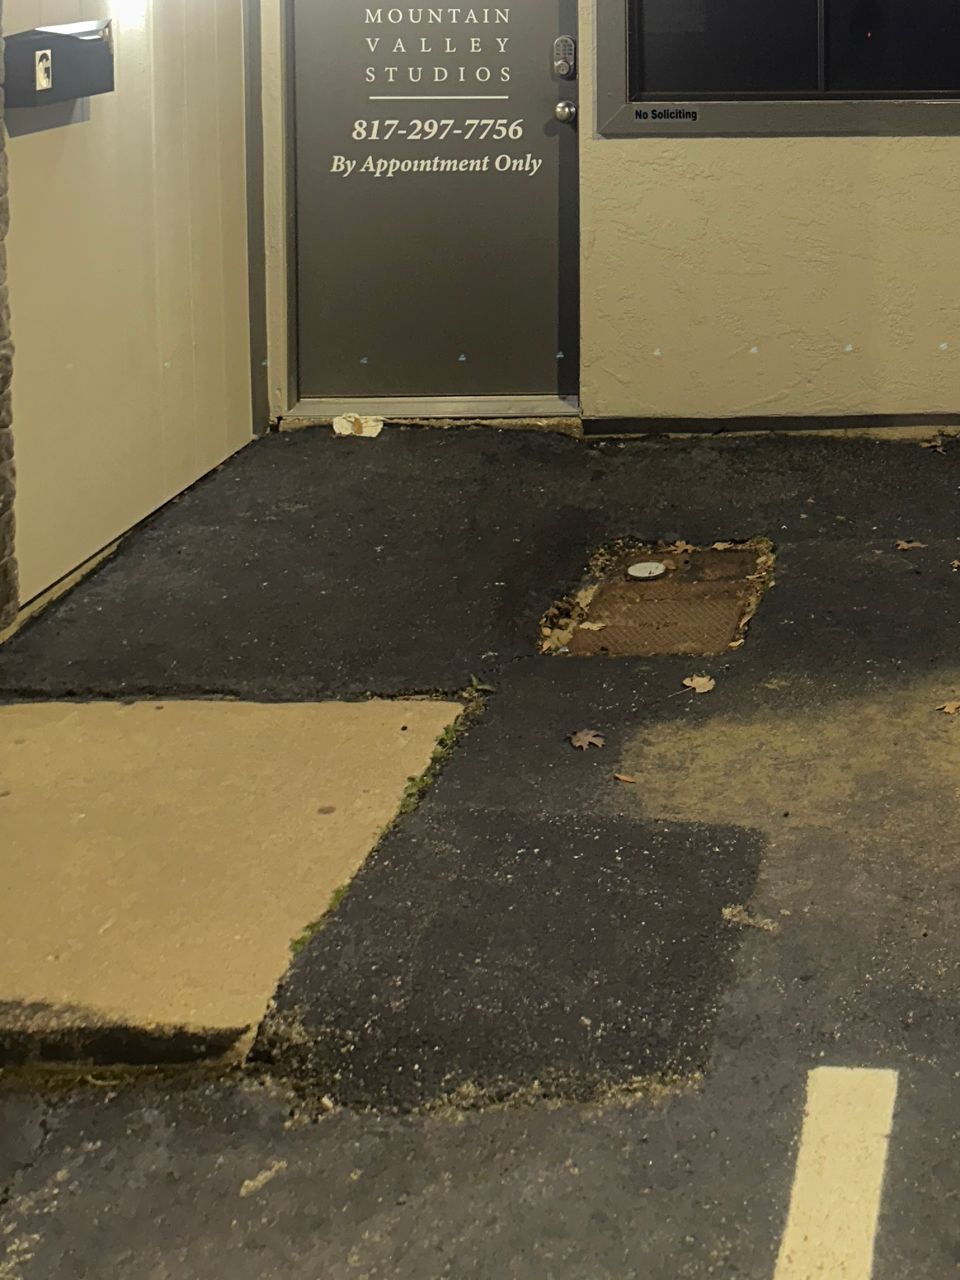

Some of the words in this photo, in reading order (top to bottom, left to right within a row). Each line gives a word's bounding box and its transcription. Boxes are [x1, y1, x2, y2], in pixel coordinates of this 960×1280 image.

[365, 8, 510, 24] MOUNTAIN
[365, 37, 510, 53] VALLEY
[365, 65, 511, 82] STUDIOS
[635, 109, 649, 120] No
[651, 108, 698, 122] Soliciting
[352, 119, 524, 140] 817-297-7756
[330, 155, 356, 177] By
[360, 155, 490, 177] Appointment
[494, 153, 543, 177] Only
